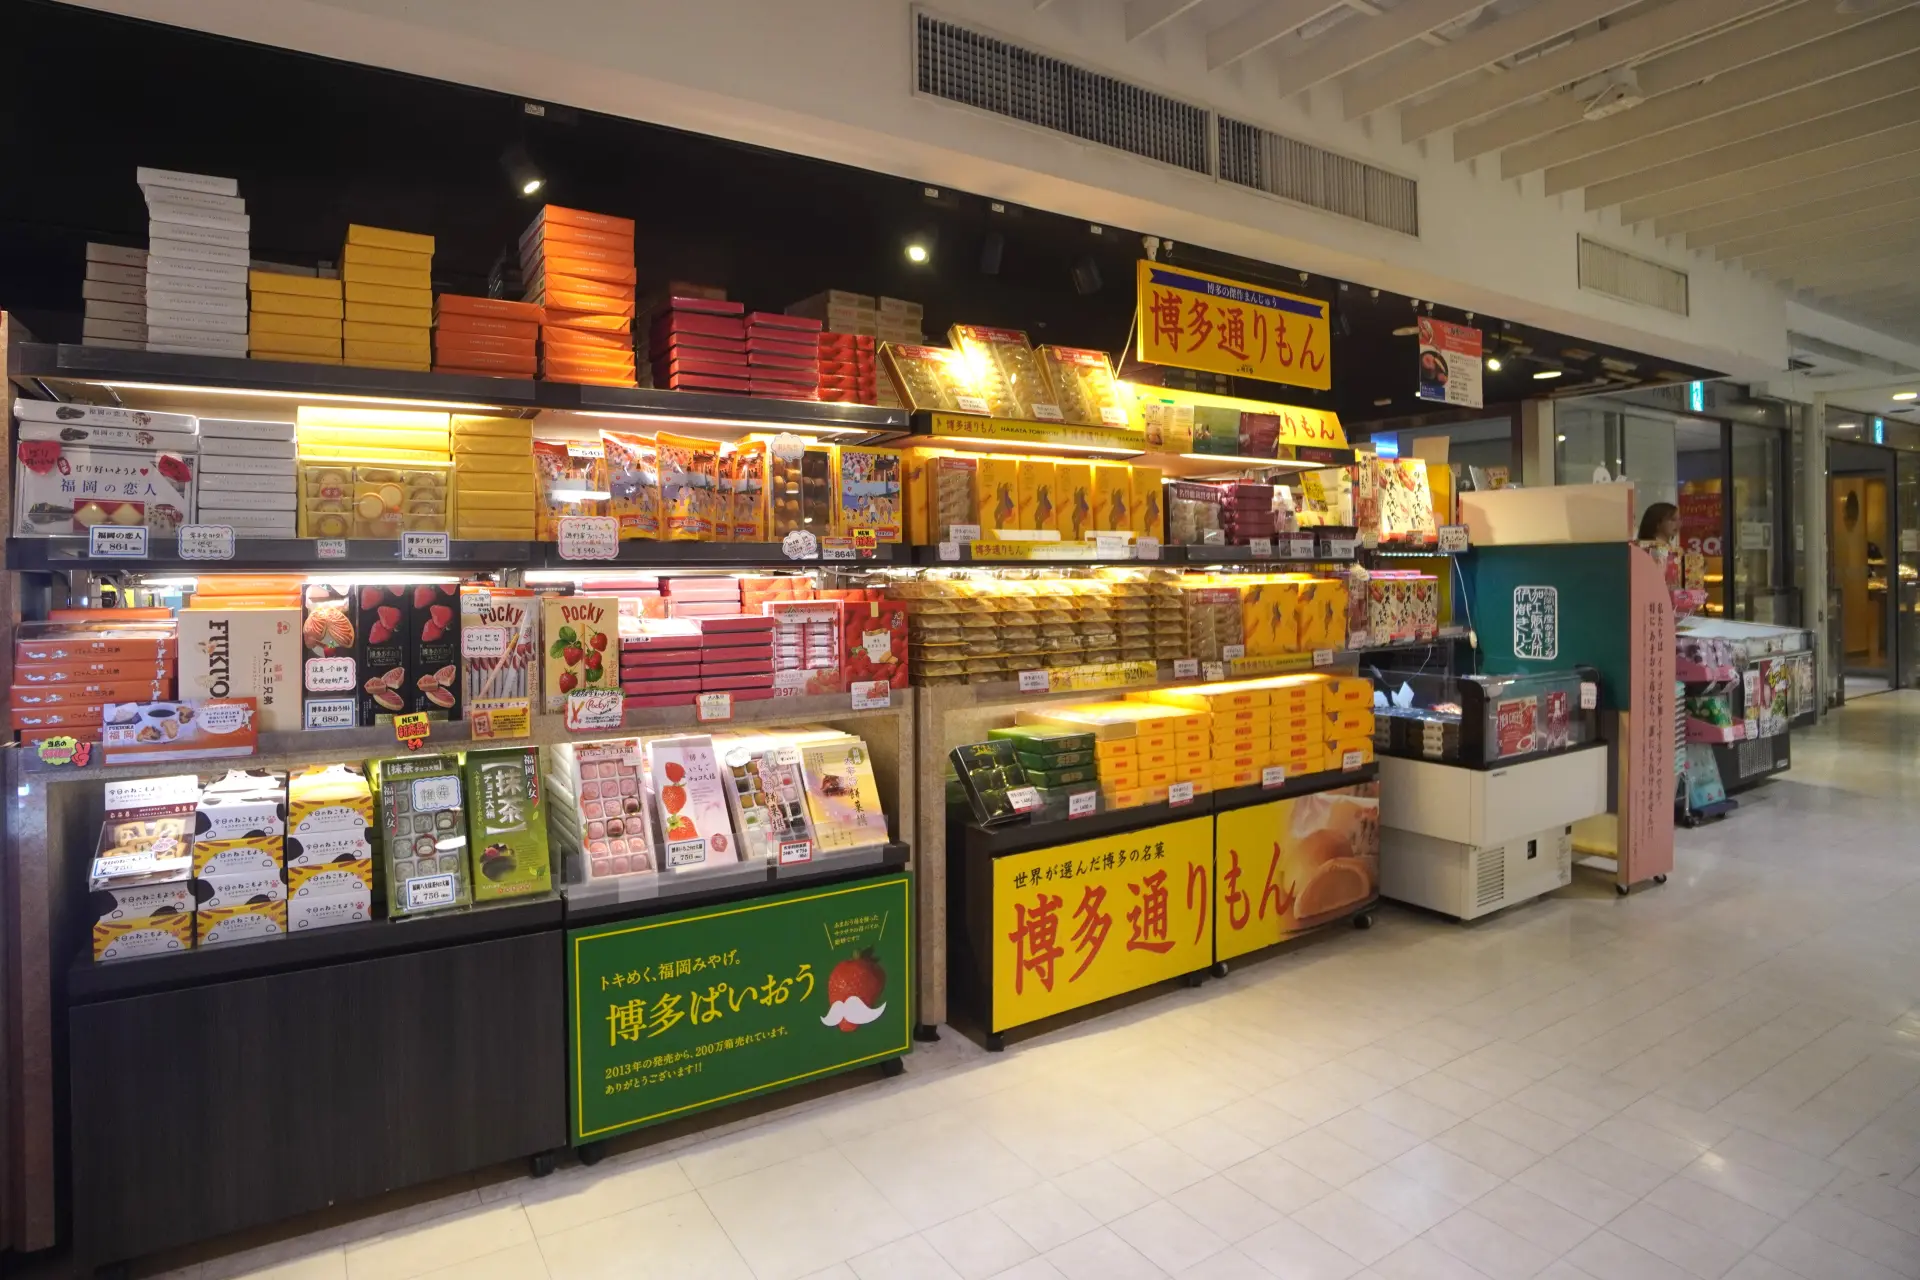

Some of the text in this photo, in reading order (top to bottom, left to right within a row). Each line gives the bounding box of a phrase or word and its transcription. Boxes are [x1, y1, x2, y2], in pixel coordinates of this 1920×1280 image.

[1207, 282, 1277, 308] 博多の傑作まんじゅう
[1149, 288, 1325, 373] 博多通りもん
[89, 408, 129, 419] 福岡の恋人
[946, 419, 996, 434] 博多通りもん
[1000, 426, 1027, 434] HAKATA
[92, 428, 132, 439] 福岡の恋人
[60, 478, 158, 497] 福岡の恋人
[97, 531, 142, 541] 福岡の恋人
[417, 547, 434, 555] 810
[975, 545, 1024, 557] 博多通りもん
[561, 602, 605, 624] Pocky
[262, 640, 274, 705] にゃんこ三兄弟
[321, 714, 339, 723] 680
[401, 715, 420, 724] NEW
[108, 730, 136, 740] 福岡
[523, 754, 538, 799] 福岡 八女
[687, 773, 716, 782] チョコ大福
[484, 775, 496, 820] チョコ大福
[495, 768, 525, 824] 抹茶
[308, 807, 356, 817] 今日のねこもよう
[383, 786, 396, 828] 福岡 八女
[215, 815, 266, 825] 今日のねこもよう
[306, 840, 355, 850] 今日のねこもよう
[213, 849, 264, 860] 今日のねこもよう
[1013, 841, 1166, 890] 世界が選んだ博多の名菓
[306, 871, 355, 882] 今日のねこもよう
[218, 881, 269, 892] 今日のねこもよう
[120, 890, 176, 905] 今日のねこもよう
[423, 892, 440, 901] 756
[306, 902, 354, 914] 今日のねこもよう
[216, 914, 268, 927] 今日のねこもよう
[1008, 841, 1297, 996] 博多通りもん
[113, 929, 169, 943] 今日のねこもよう
[600, 949, 741, 992] トキめく、福岡みやげ。
[605, 963, 816, 1047] 博多ぱいおう
[604, 1025, 789, 1080] 2013年の発売から、200万箱売れています。
[604, 1062, 703, 1096] ありがとうございます!!
